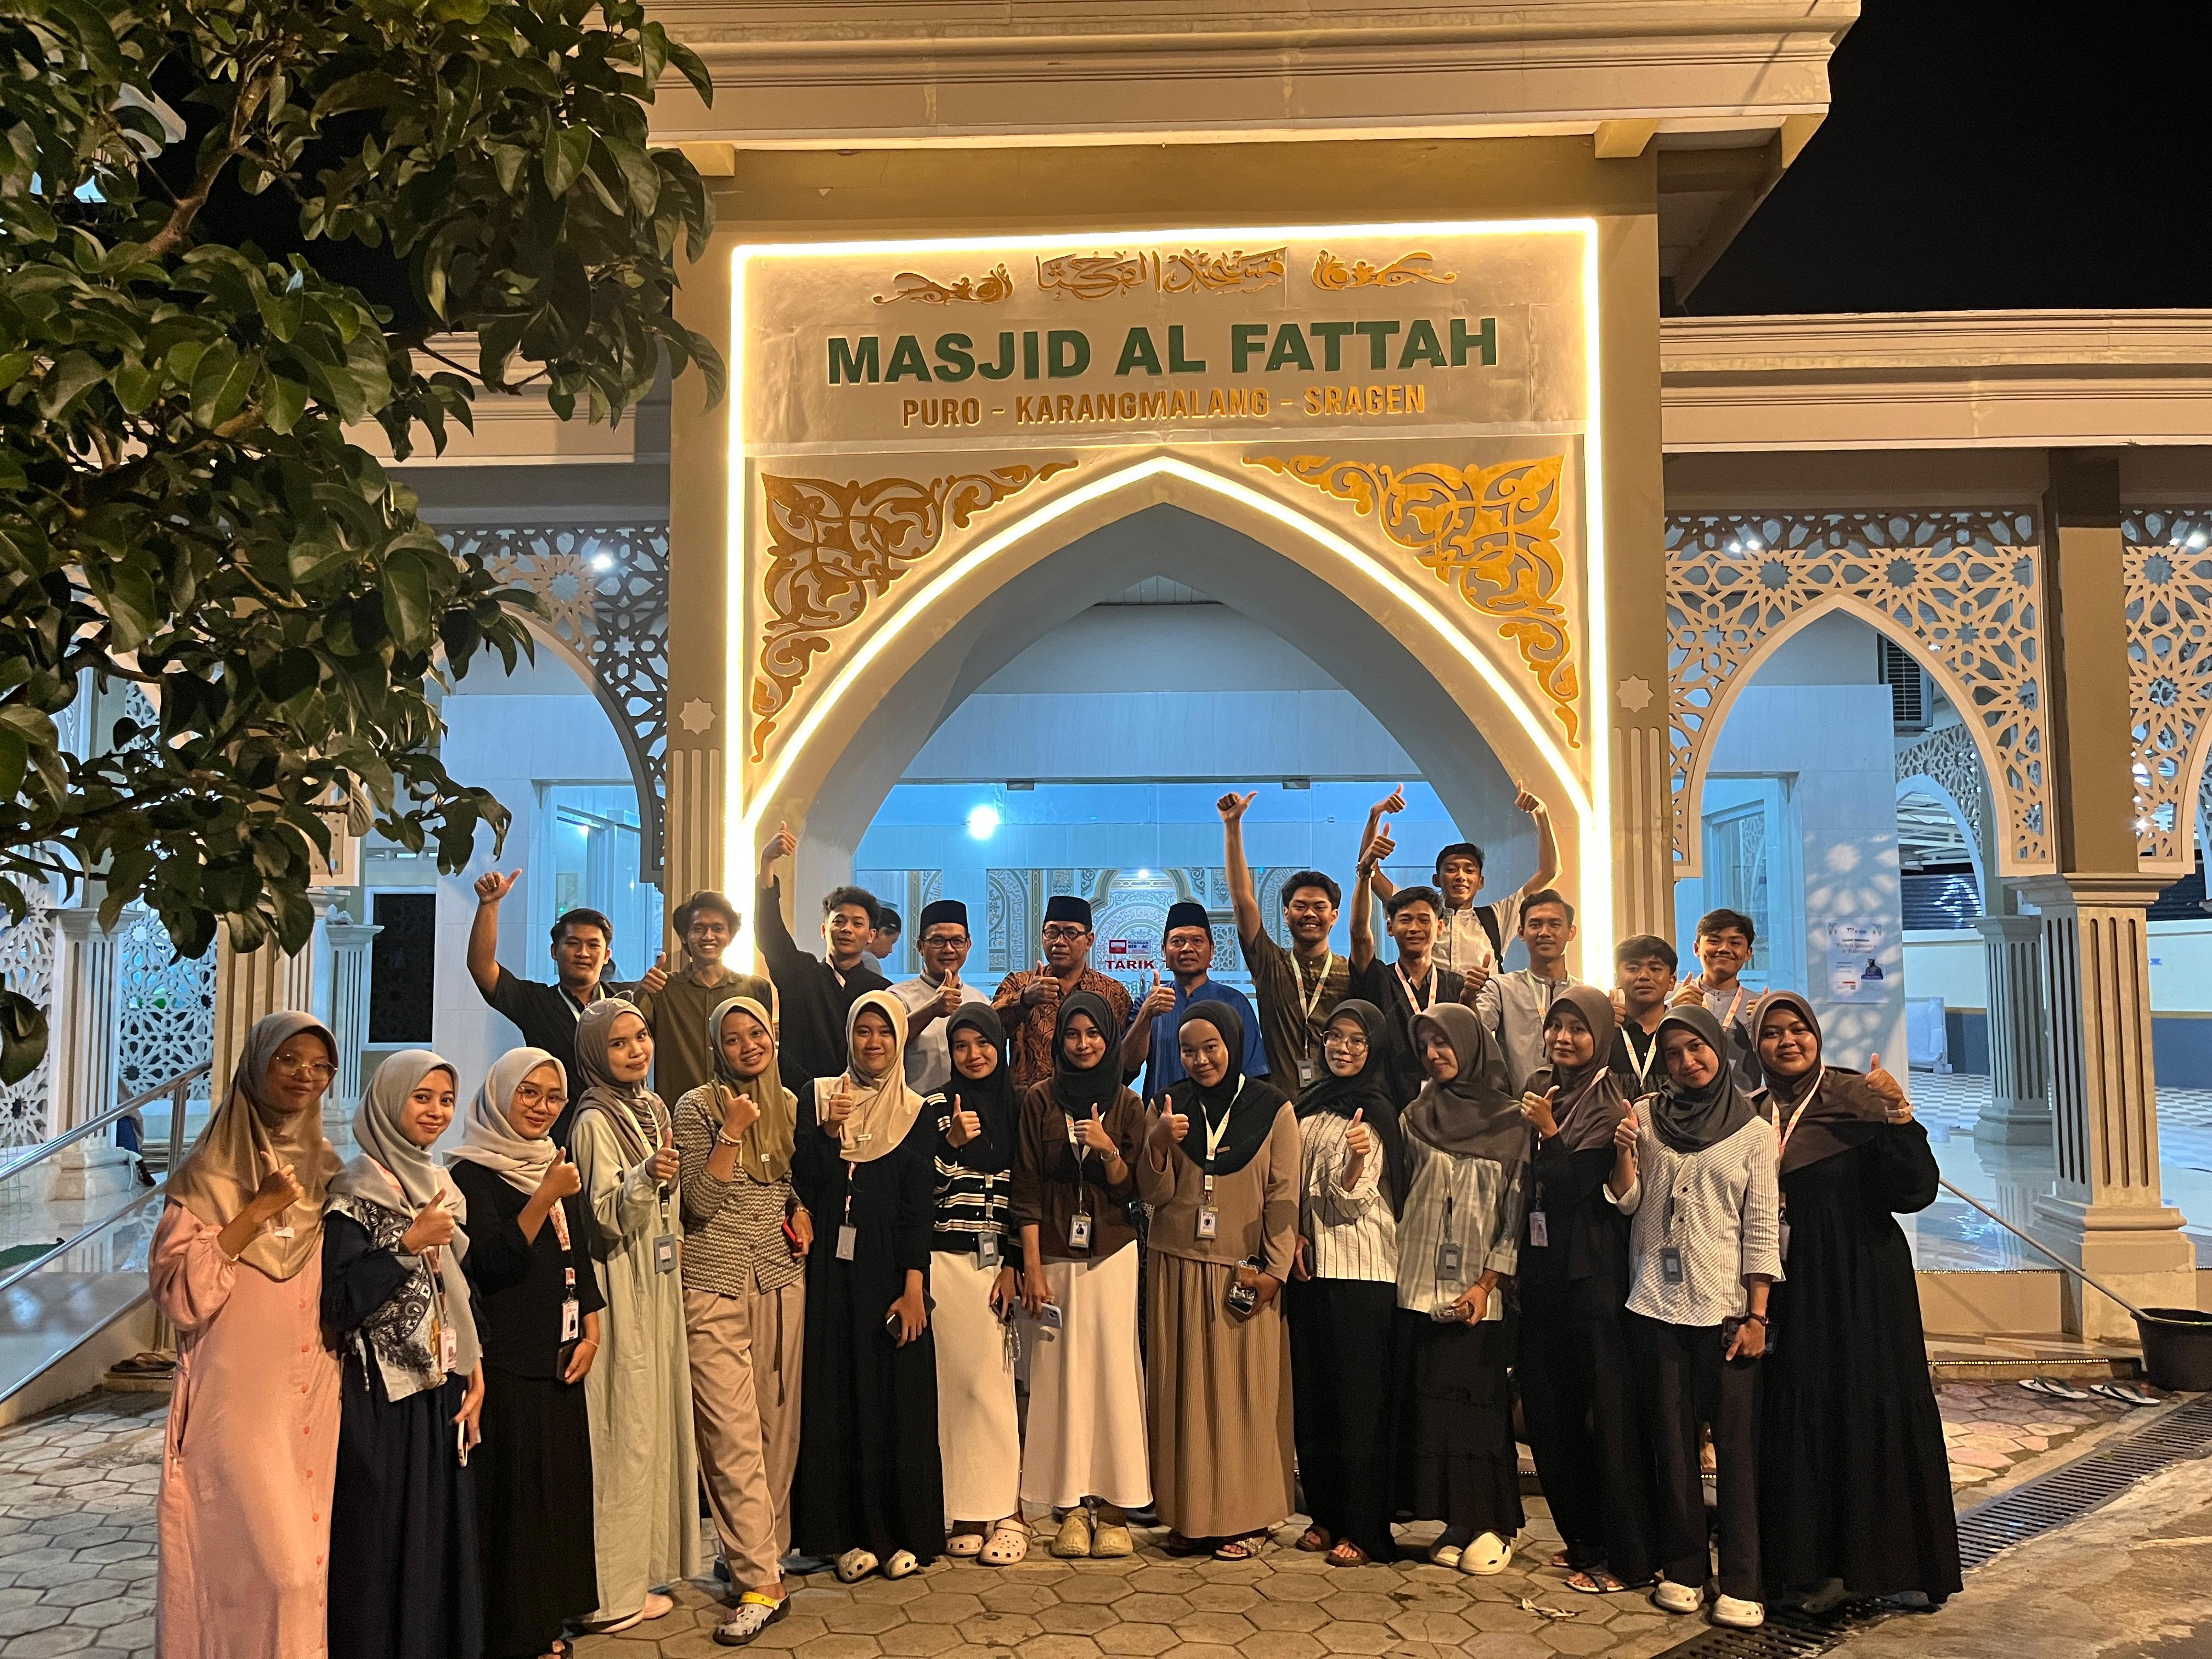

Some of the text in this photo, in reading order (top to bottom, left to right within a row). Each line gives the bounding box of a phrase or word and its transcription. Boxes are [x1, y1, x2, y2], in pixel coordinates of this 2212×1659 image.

[828, 318, 1497, 385] MASJID AL FATTAH
[903, 397, 981, 427] PURO
[1016, 388, 1269, 424] KARANGMALANG
[1304, 385, 1425, 416] SRAGEN
[1105, 960, 1155, 969] TARIK
